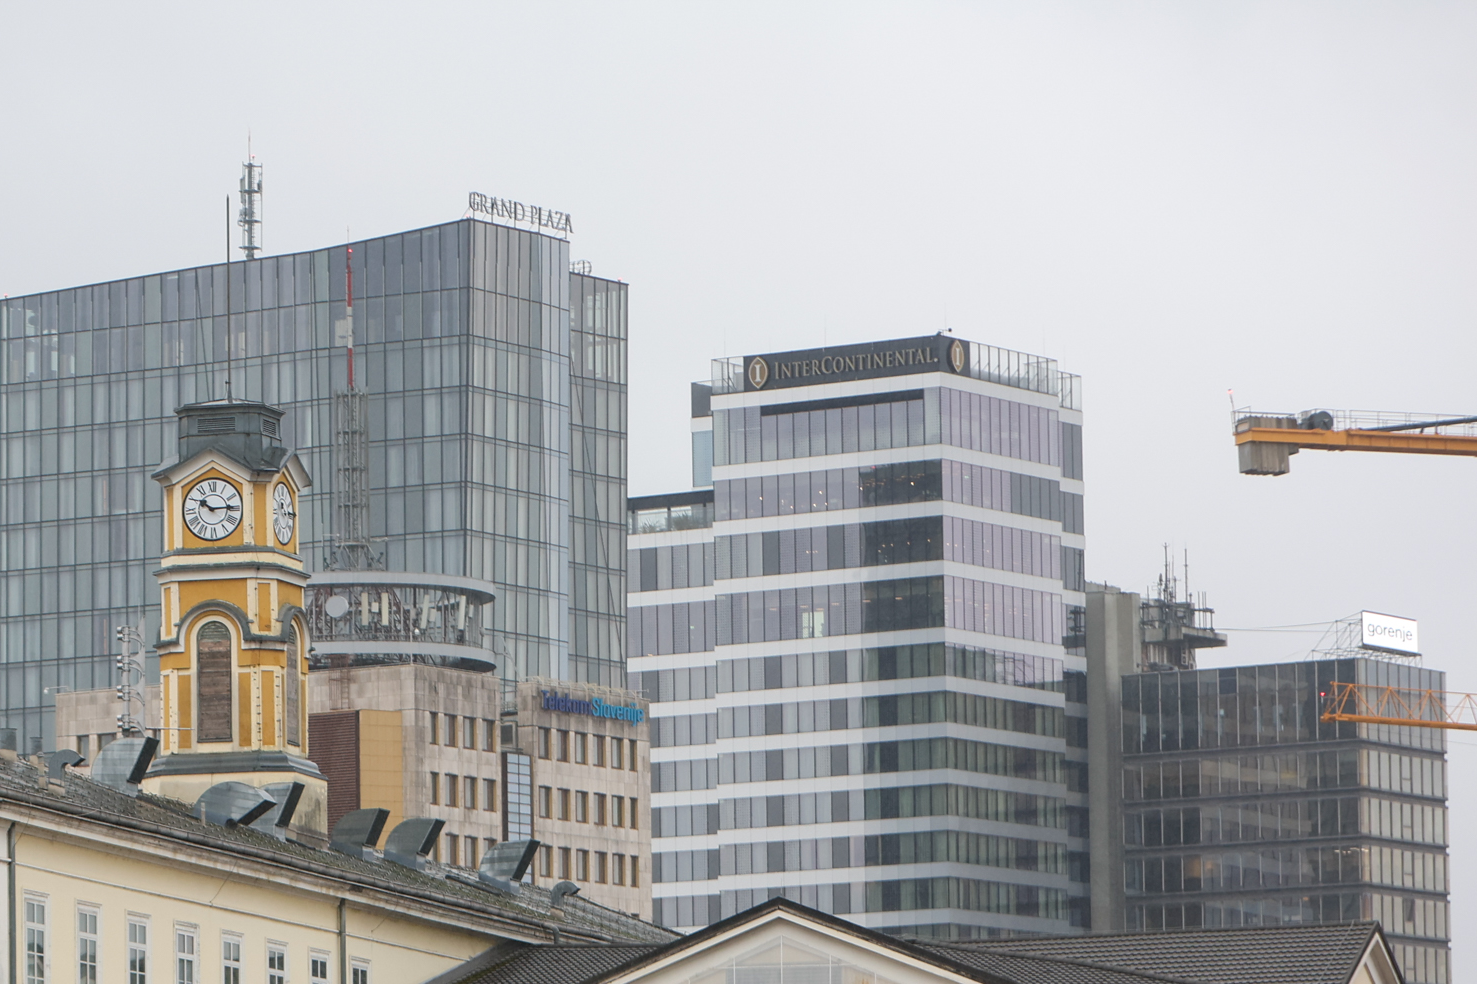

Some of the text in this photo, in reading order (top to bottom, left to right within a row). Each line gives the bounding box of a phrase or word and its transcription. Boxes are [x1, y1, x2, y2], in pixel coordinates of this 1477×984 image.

[469, 191, 574, 234] GRAND PLAZA
[1367, 623, 1413, 642] gorenje
